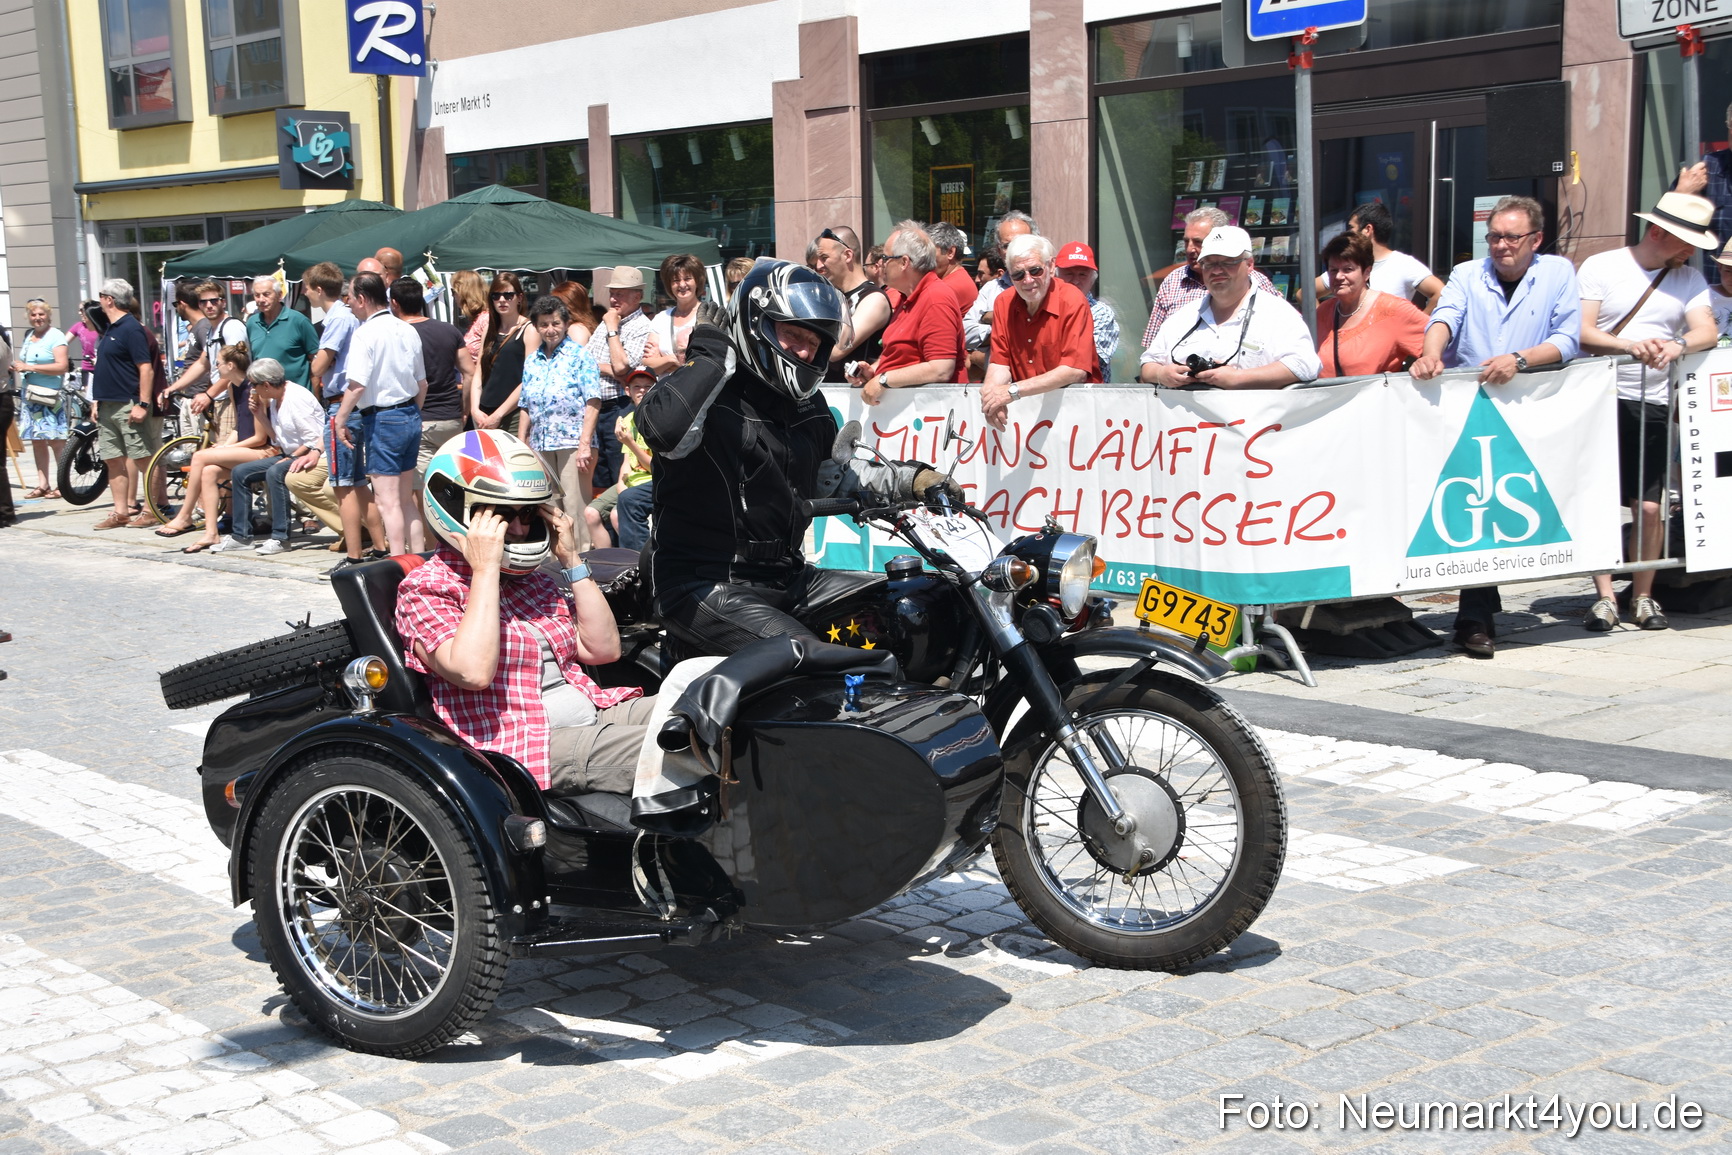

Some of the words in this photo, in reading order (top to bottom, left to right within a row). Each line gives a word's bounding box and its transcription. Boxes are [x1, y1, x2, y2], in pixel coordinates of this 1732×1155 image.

[1652, 0, 1718, 23] ZONE
[434, 101, 460, 116] Unterer
[461, 97, 481, 111] Markt
[482, 93, 491, 108] 15
[940, 181, 965, 193] WEBER'S
[940, 193, 965, 209] GRILL
[956, 420, 1053, 469] UNS
[1686, 372, 1706, 548] RESIDENZPLATZ
[936, 519, 967, 536] 343
[1101, 489, 1347, 546] BESSER.
[1406, 565, 1431, 579] Jura
[1436, 558, 1489, 576] Gebäude
[1493, 554, 1535, 570] Service
[1540, 549, 1573, 565] GmbH
[1143, 585, 1232, 635] G9743
